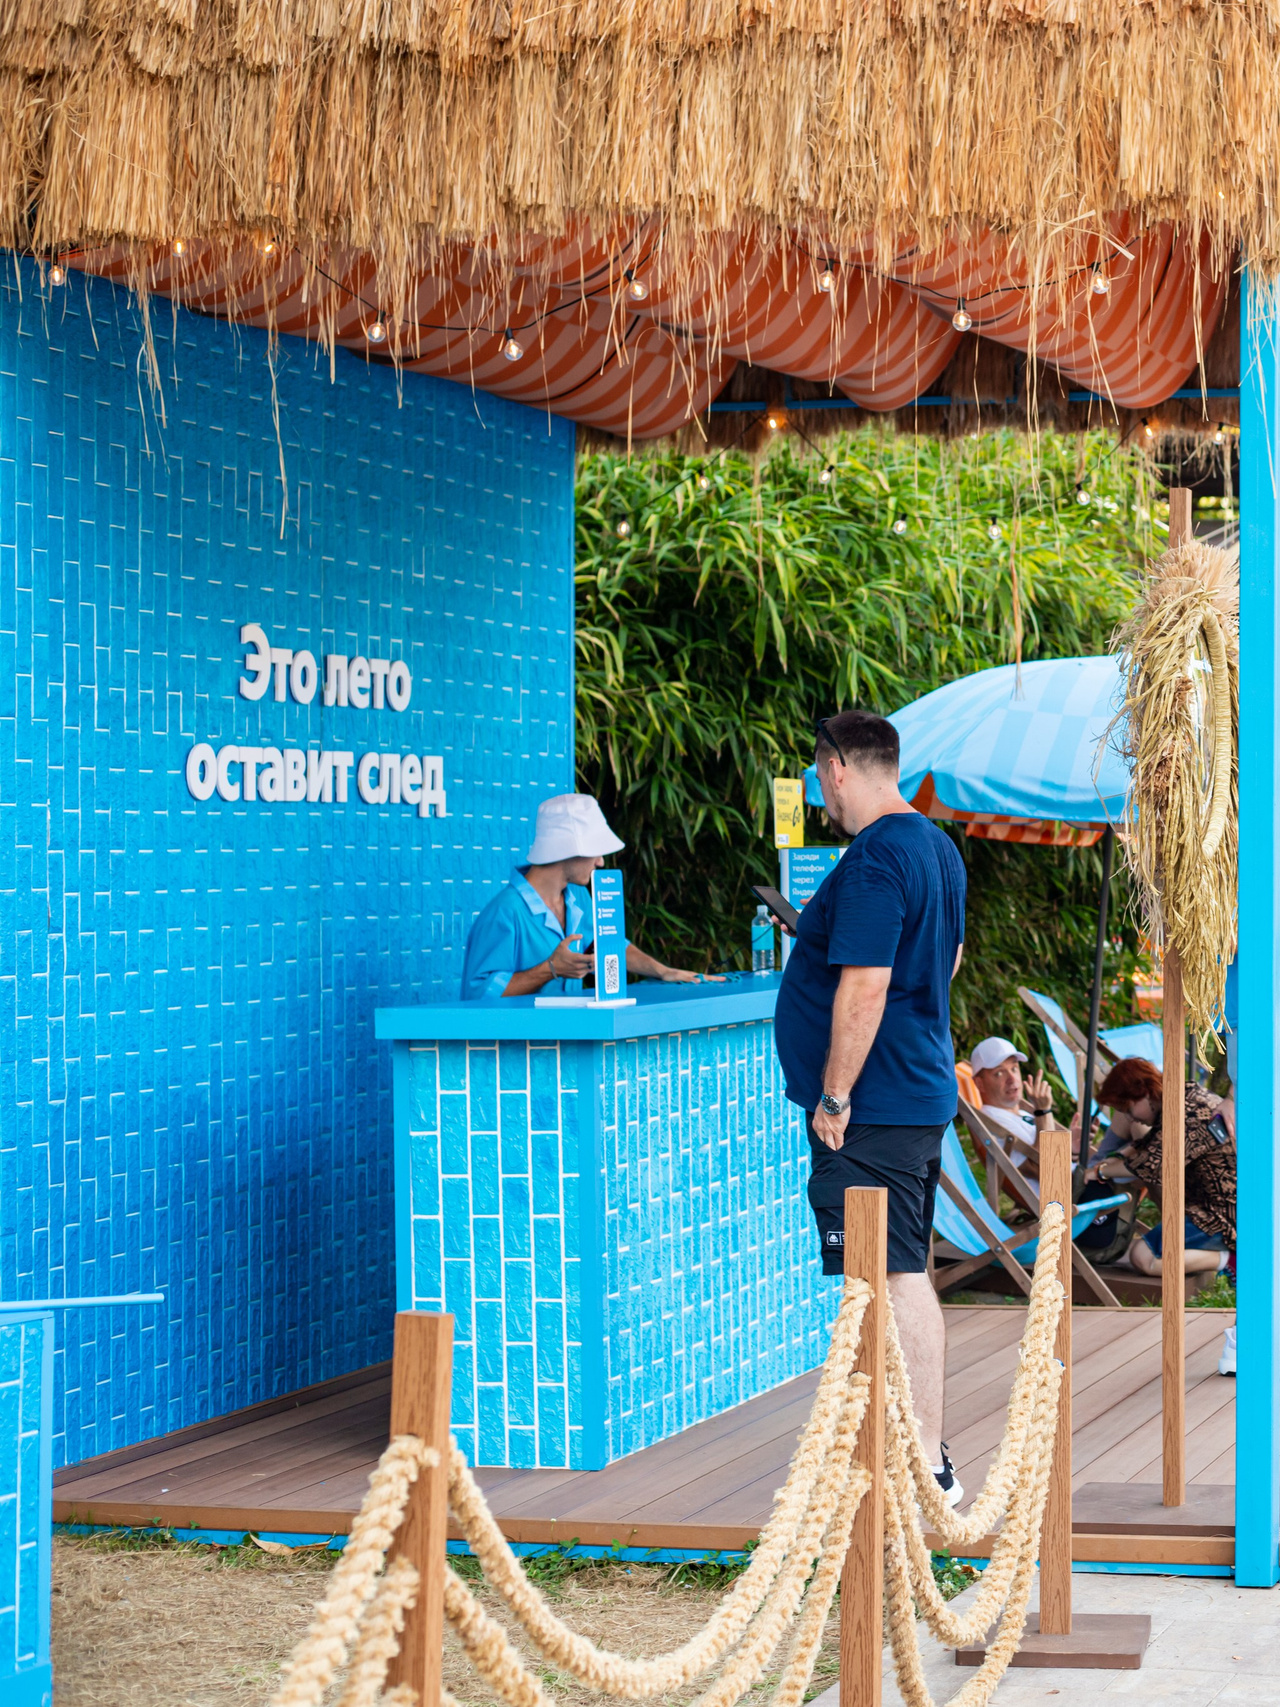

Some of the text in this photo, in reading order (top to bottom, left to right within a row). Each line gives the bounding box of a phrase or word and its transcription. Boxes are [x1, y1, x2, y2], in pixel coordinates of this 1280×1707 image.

[238, 623, 412, 713] Это лето
[185, 742, 447, 818] оставит след
[792, 852, 820, 861] Заряди
[792, 864, 825, 873] телефон
[792, 877, 814, 885] через
